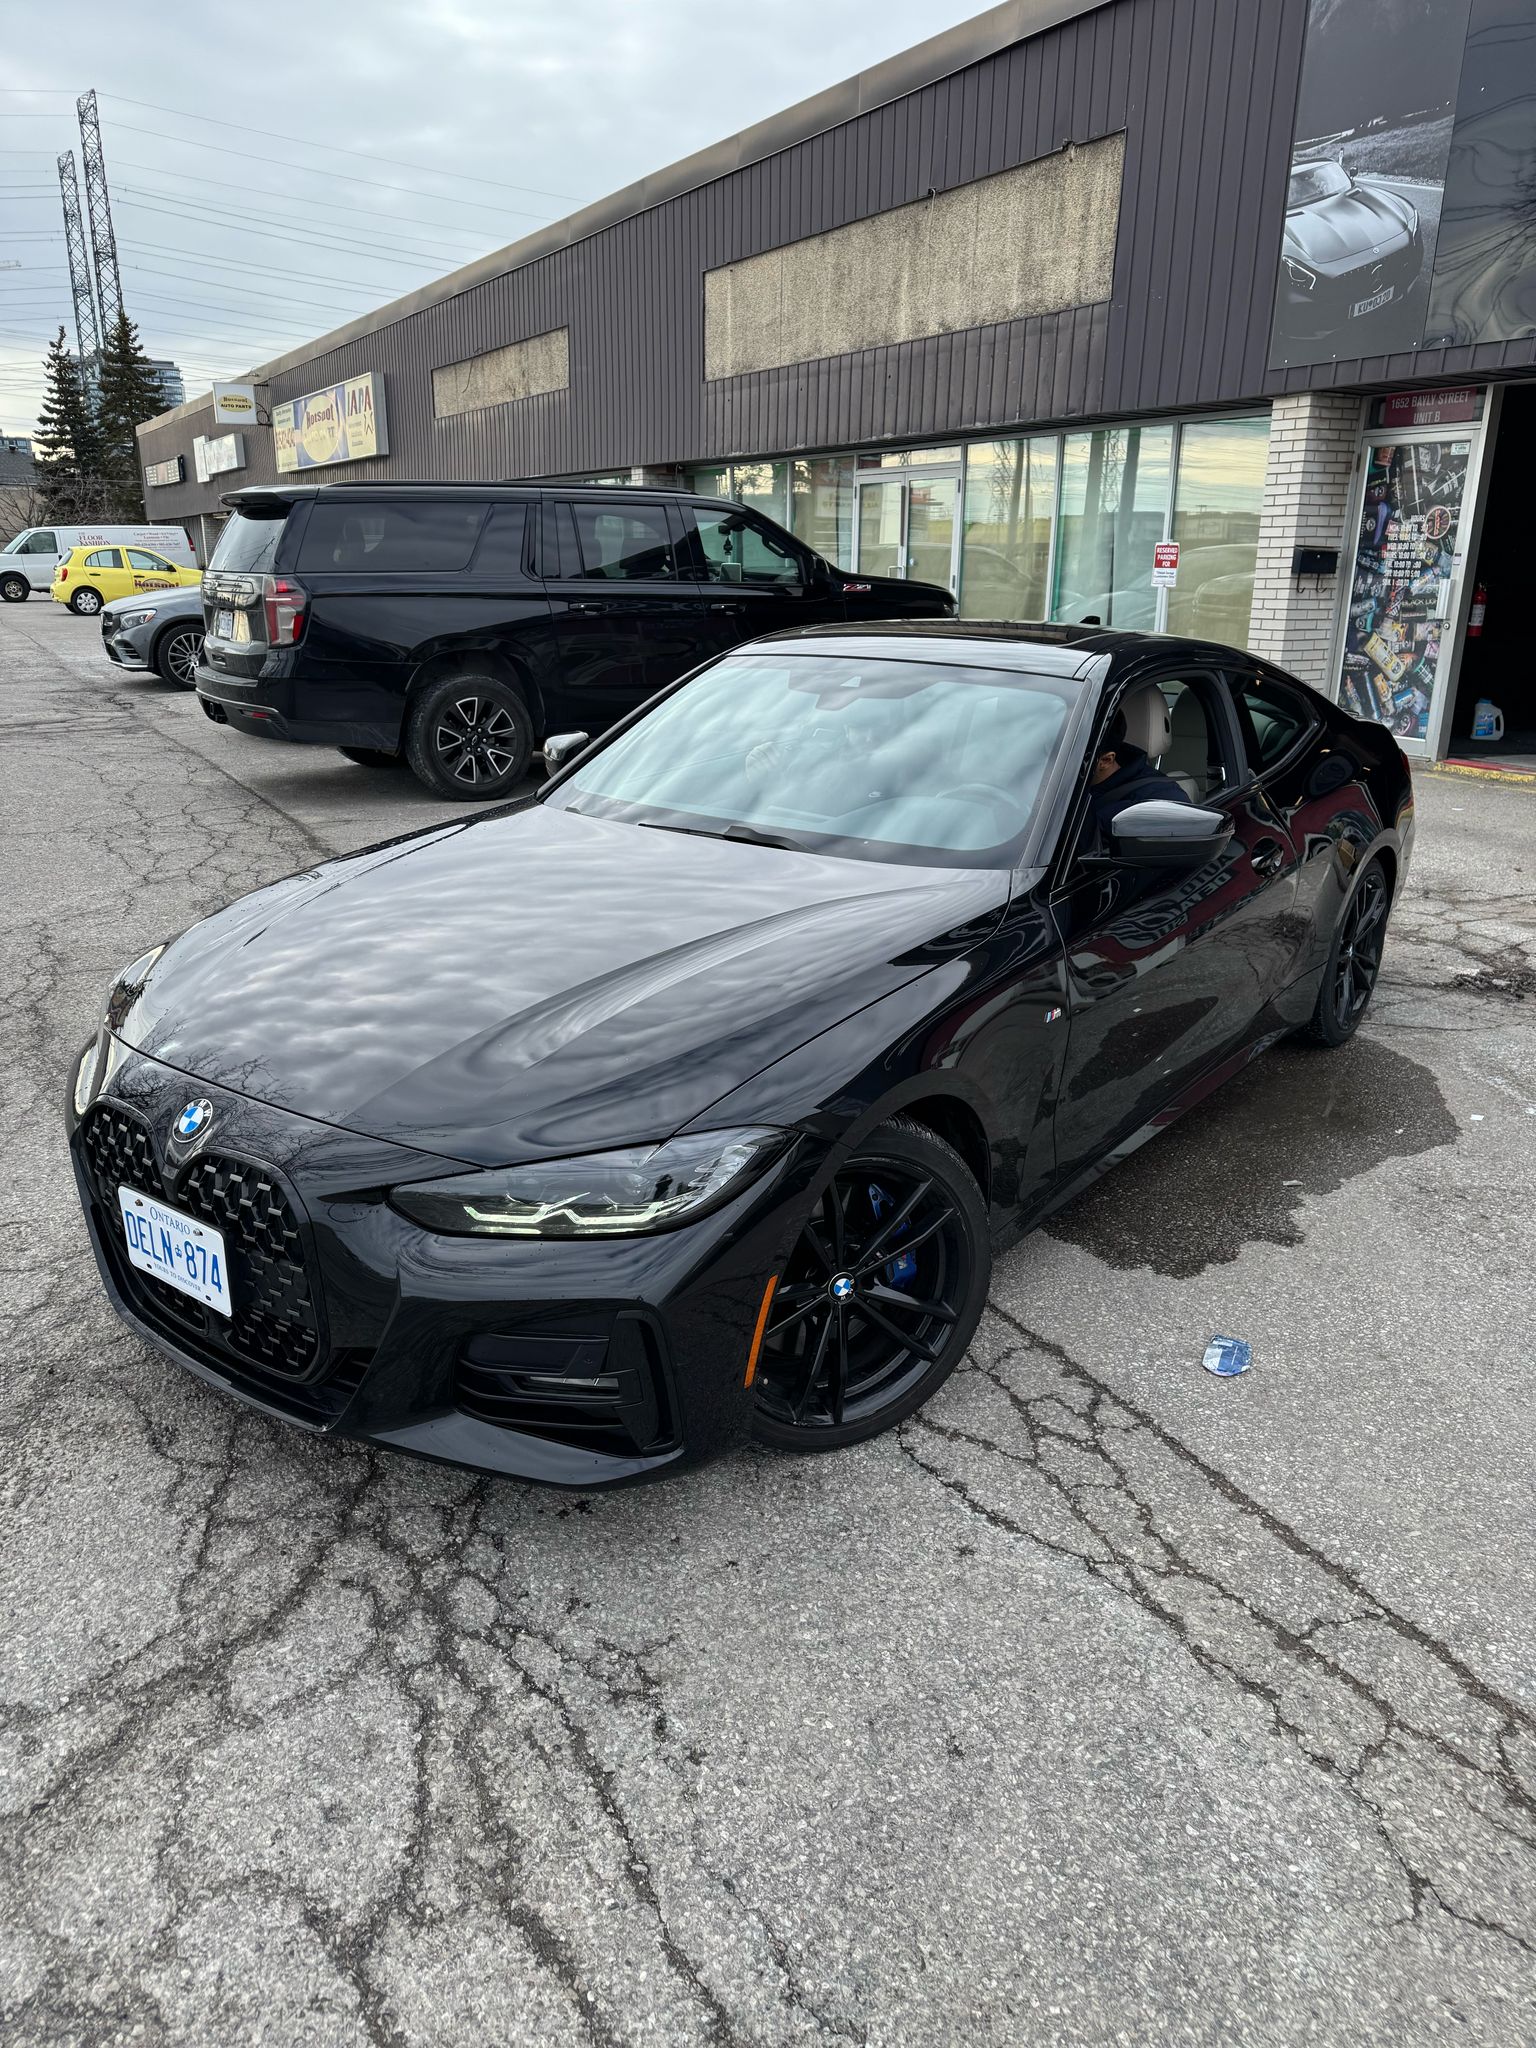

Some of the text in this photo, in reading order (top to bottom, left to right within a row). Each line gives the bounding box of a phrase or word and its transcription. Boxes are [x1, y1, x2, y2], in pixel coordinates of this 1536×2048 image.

[1392, 390, 1470, 409] 1652 BAYLY STREET
[1413, 411, 1440, 424] UNIT B
[149, 1206, 191, 1235] ONTARIO
[125, 1210, 222, 1293] DELN 874
[170, 1270, 177, 1279] TO
[177, 1274, 202, 1292] DISCOVER
